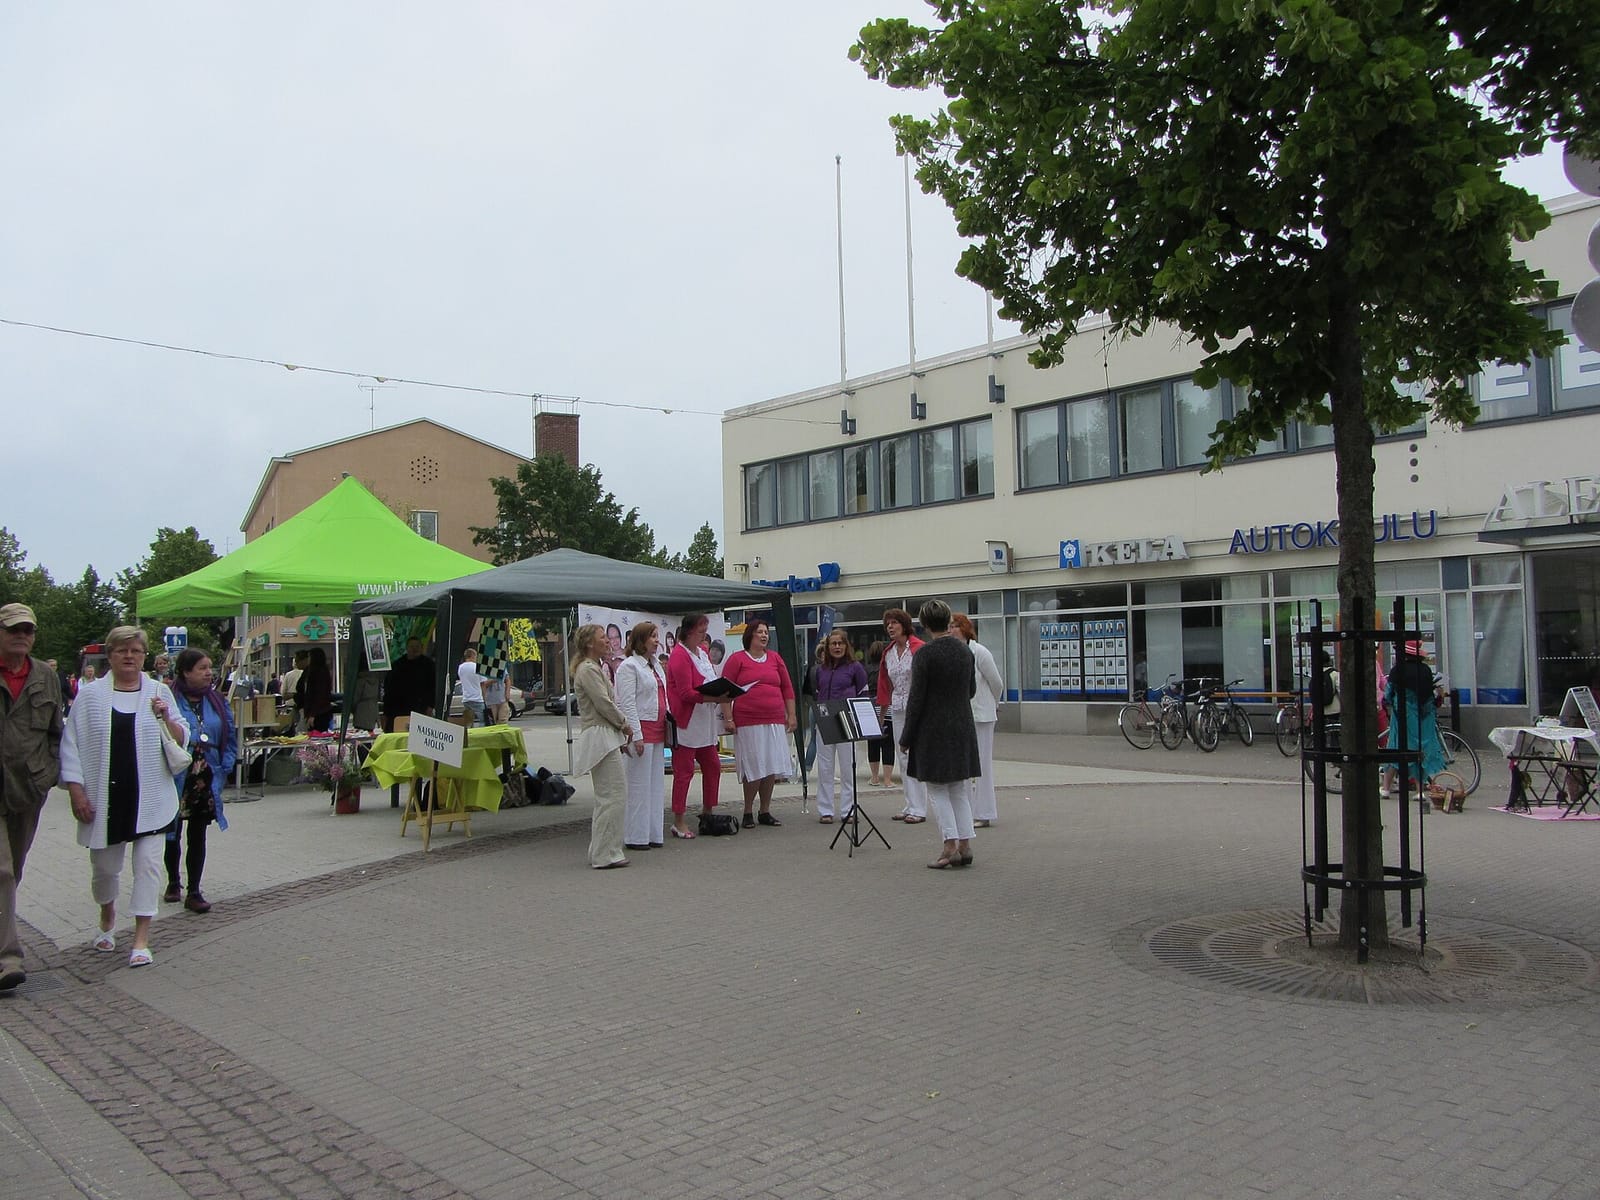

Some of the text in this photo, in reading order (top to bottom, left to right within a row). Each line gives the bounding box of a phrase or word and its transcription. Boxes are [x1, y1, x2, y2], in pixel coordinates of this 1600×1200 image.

[1229, 509, 1438, 555] AUTOKULU
[1084, 535, 1190, 567] KELA
[416, 724, 454, 744] NAISKUORO
